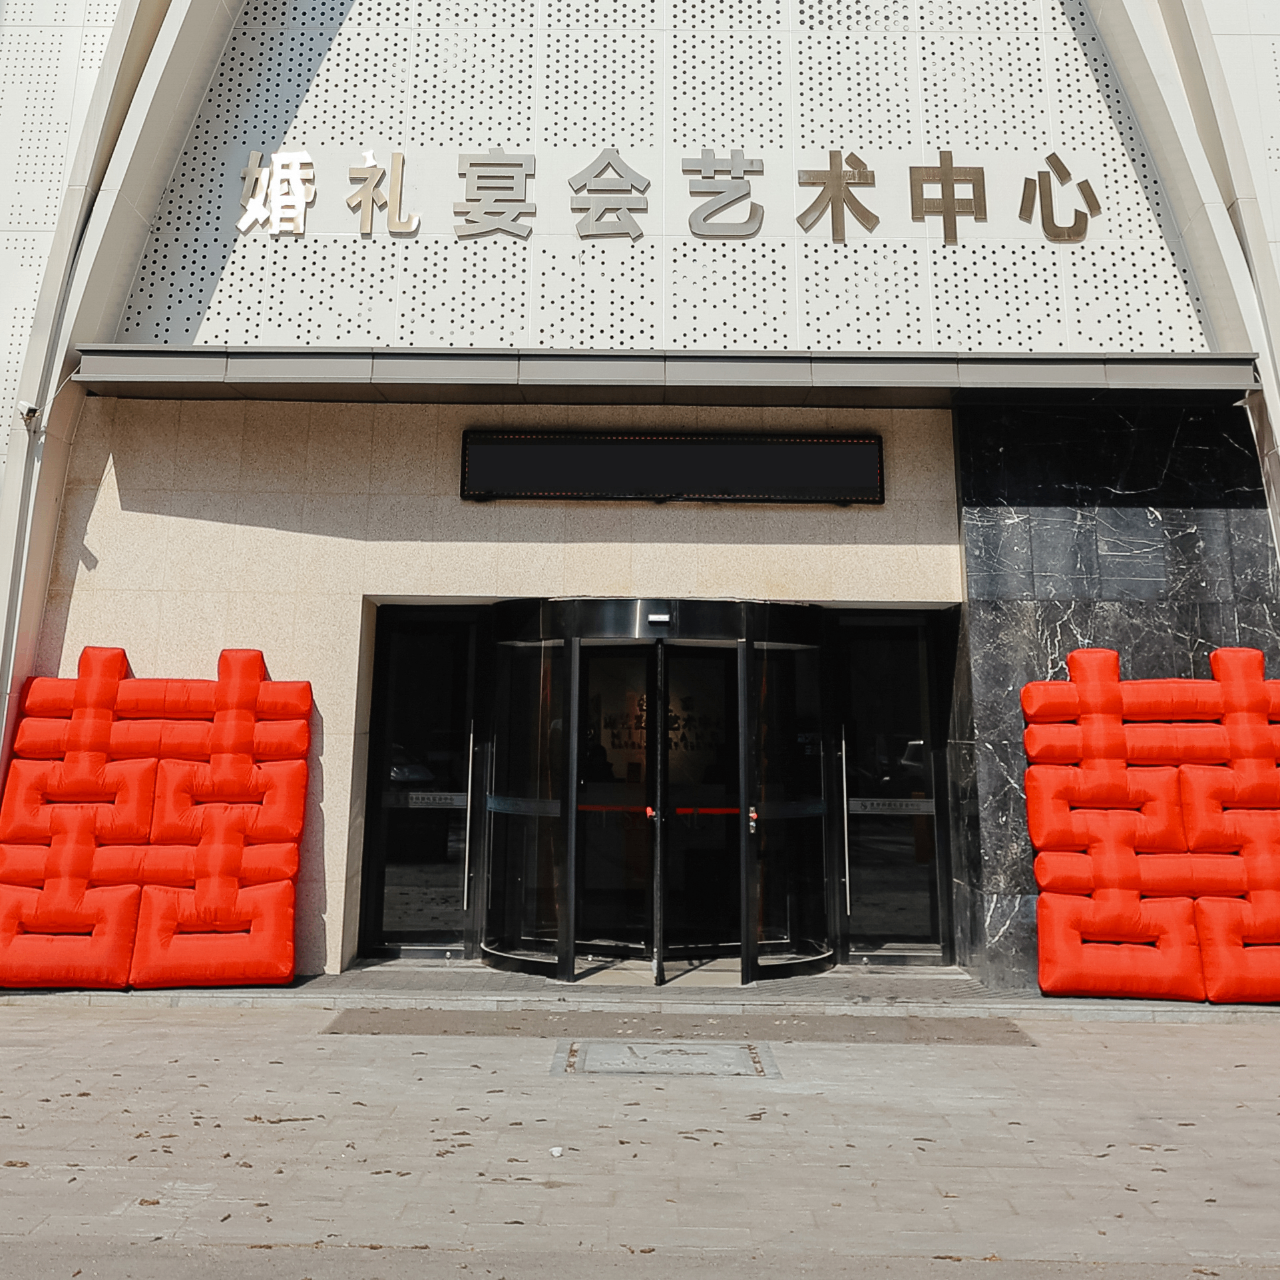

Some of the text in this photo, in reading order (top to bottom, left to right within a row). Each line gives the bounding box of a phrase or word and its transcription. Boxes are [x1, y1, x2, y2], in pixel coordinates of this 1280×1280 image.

[235, 148, 1102, 247] 婚礼宴会艺术中心
